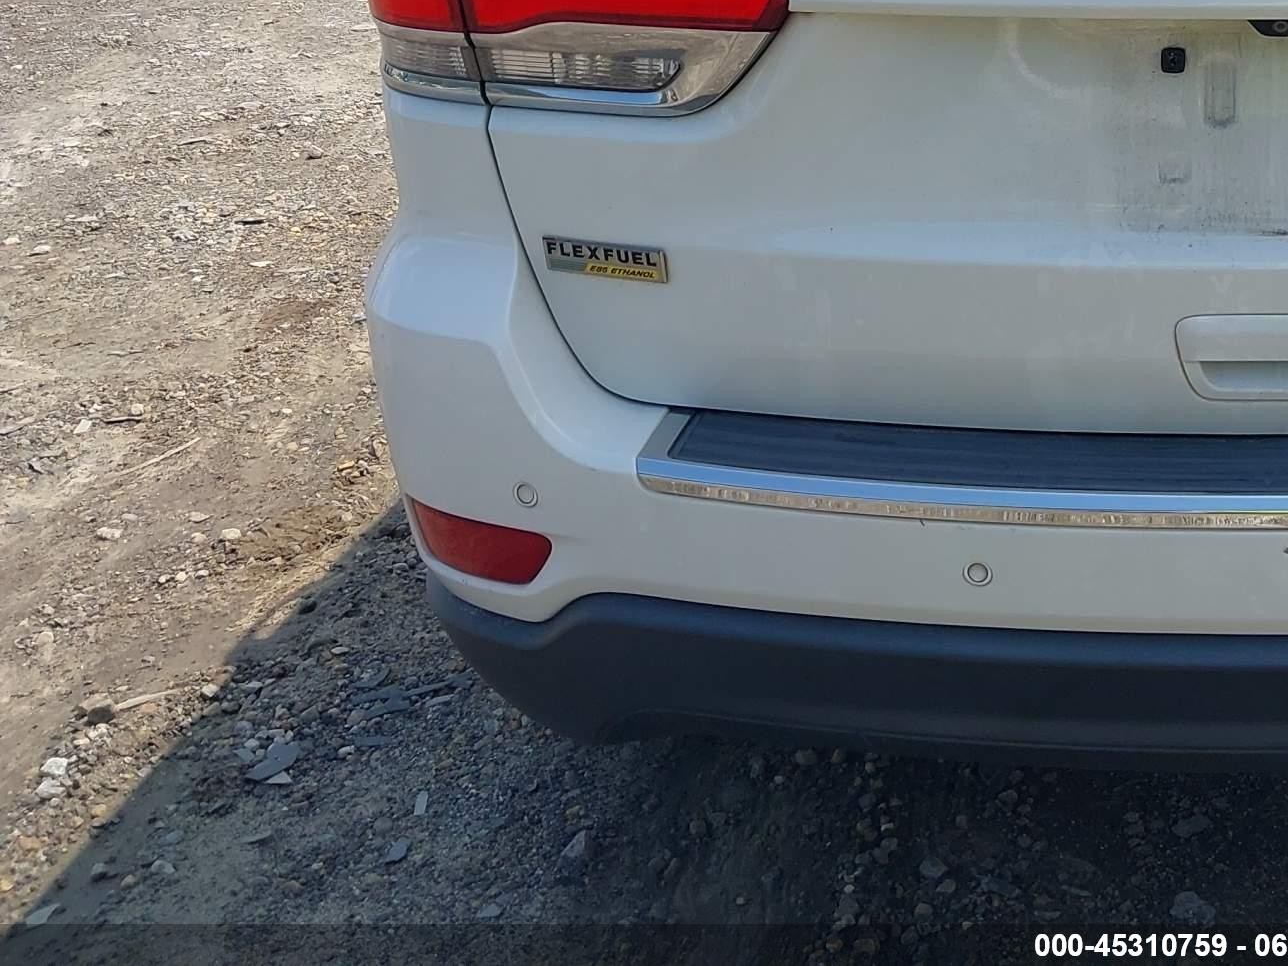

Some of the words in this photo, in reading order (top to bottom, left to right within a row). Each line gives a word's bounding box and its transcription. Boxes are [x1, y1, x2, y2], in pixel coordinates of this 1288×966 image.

[547, 241, 657, 266] FLEXFUEL
[589, 265, 608, 273] E85
[611, 267, 656, 278] ETHANOL
